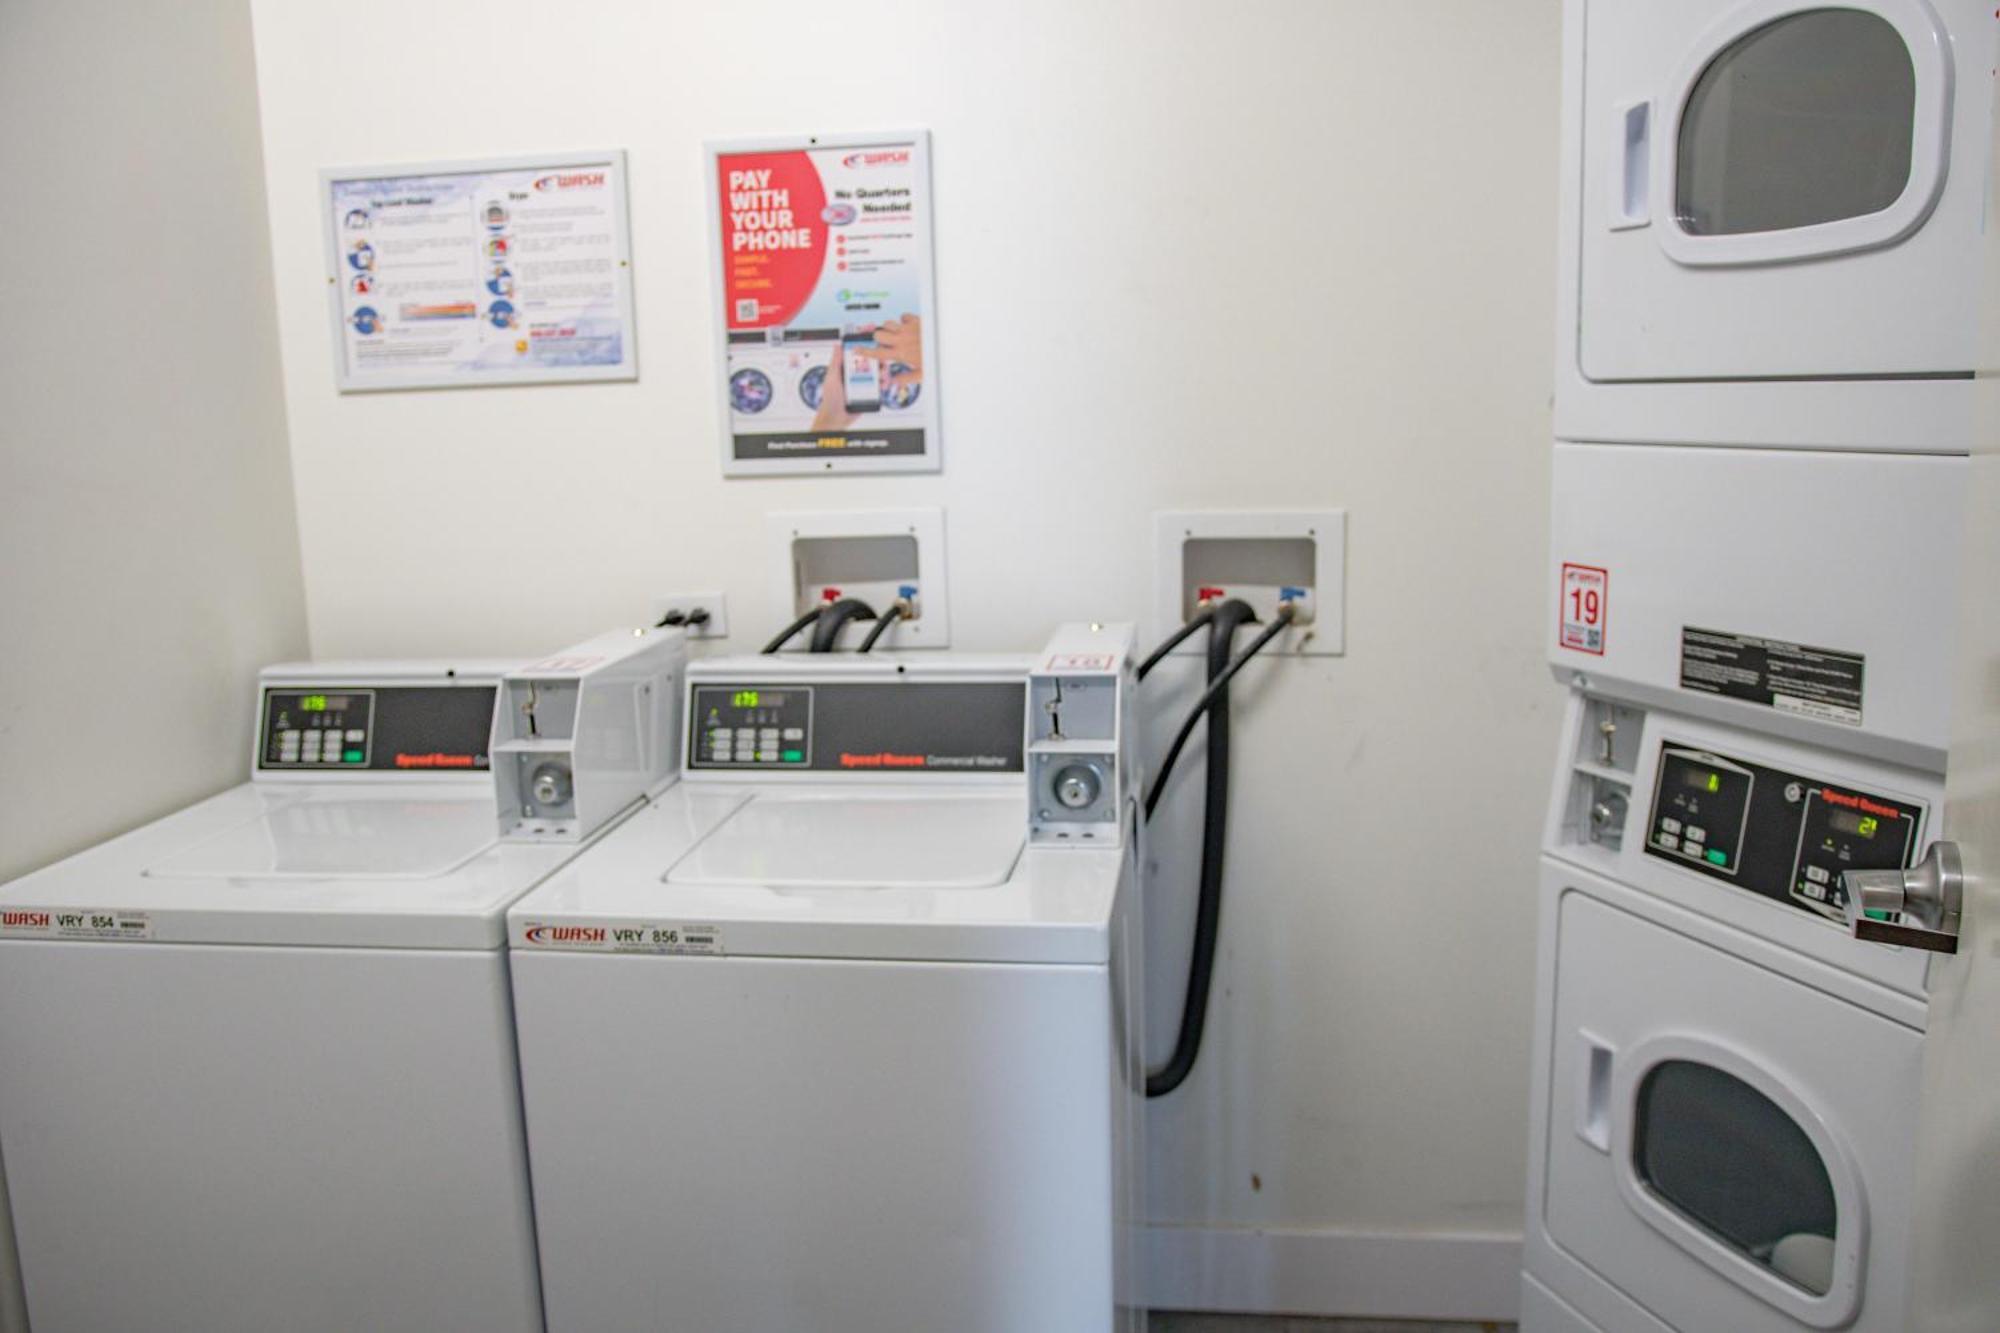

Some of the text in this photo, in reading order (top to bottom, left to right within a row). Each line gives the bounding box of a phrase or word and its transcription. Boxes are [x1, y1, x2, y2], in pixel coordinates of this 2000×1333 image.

[729, 169, 772, 191] PAY
[730, 189, 790, 211] WITH
[835, 187, 911, 199] No Quarters
[862, 202, 912, 213] Needed
[730, 208, 794, 231] YOUR
[733, 227, 812, 251] PHONE
[1570, 587, 1599, 625] 19
[840, 753, 882, 768] Speed
[882, 752, 925, 766] Queen
[927, 755, 974, 766] Commercial
[2, 911, 115, 929] WASH VRY 854
[551, 927, 679, 944] WASH VRY 856
